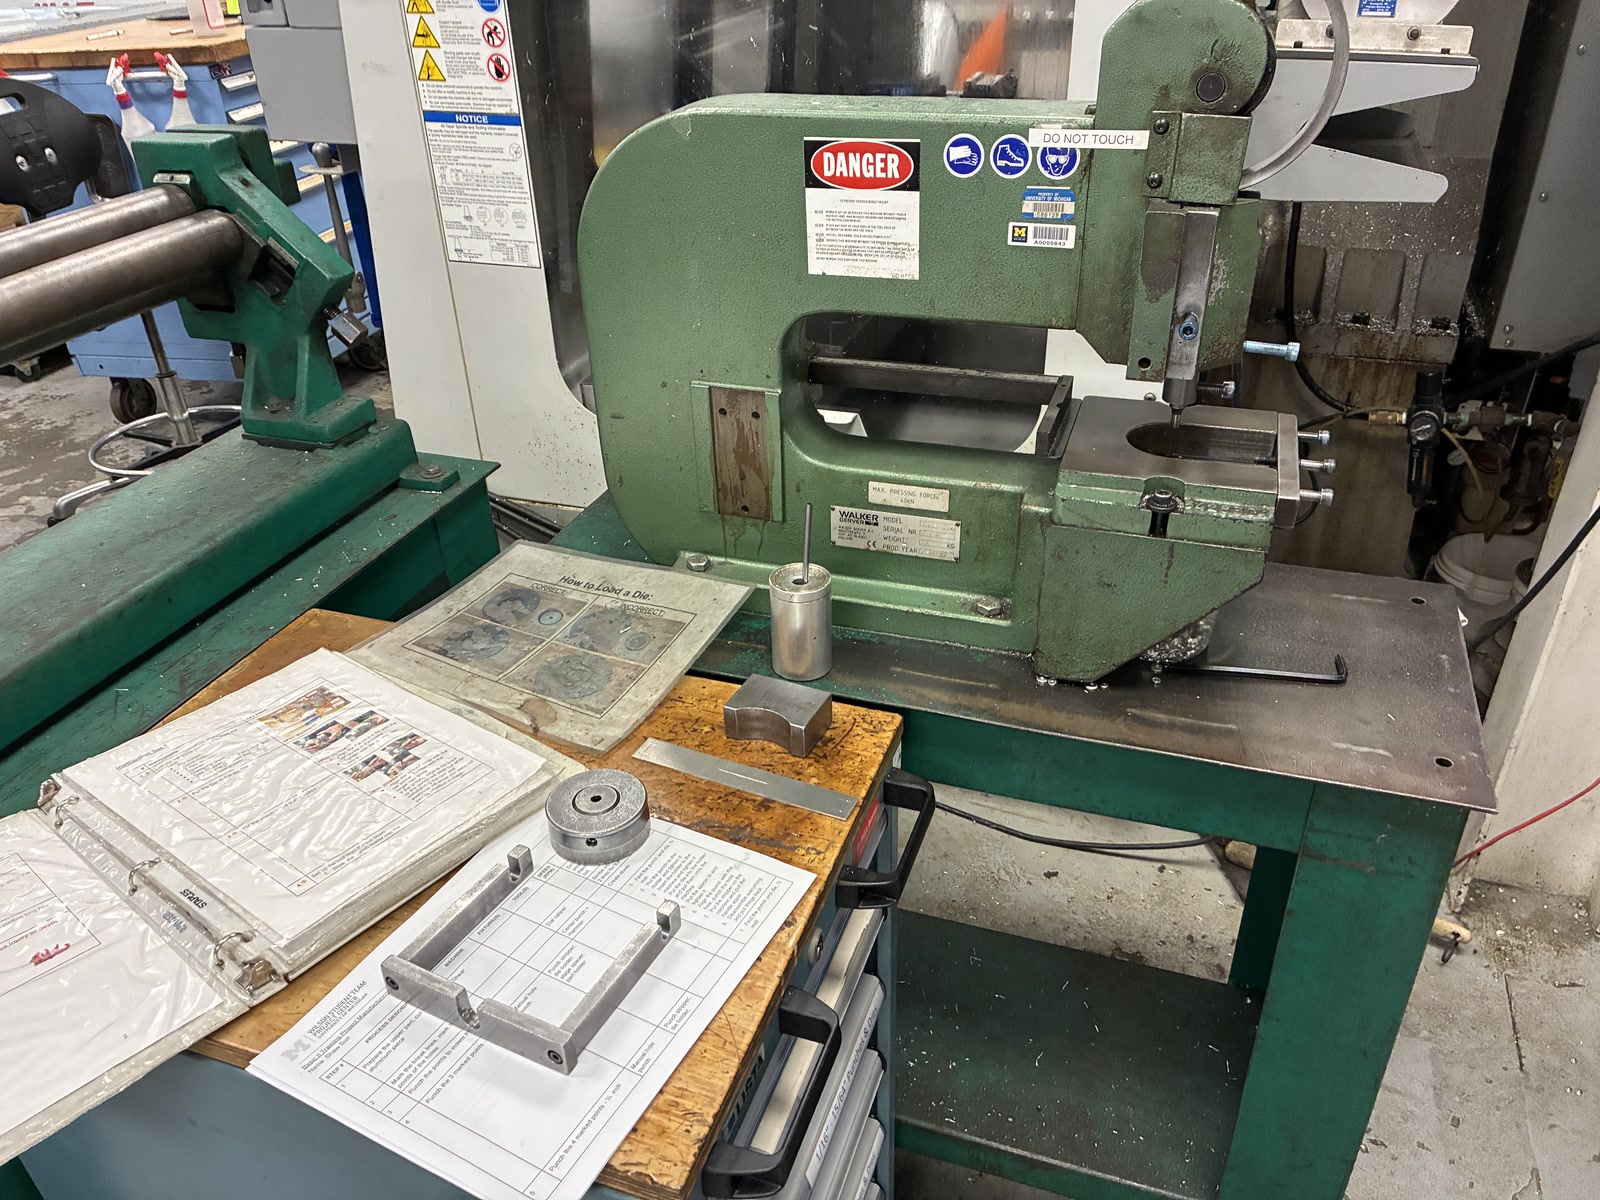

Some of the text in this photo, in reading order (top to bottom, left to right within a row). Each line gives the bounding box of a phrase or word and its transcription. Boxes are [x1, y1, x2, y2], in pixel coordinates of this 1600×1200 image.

[455, 114, 488, 124] NOTICE
[1043, 133, 1134, 145] DO NOT TOUCH
[823, 152, 900, 179] DANGER
[890, 488, 916, 497] PRESSING
[838, 510, 879, 521] WALKER
[883, 516, 902, 524] MODEL
[883, 525, 904, 534] SERIAL
[883, 535, 906, 544] WEIGHT
[901, 545, 918, 554] YEAR
[559, 575, 584, 586] How
[584, 581, 594, 590] to
[595, 584, 624, 596] Load
[631, 590, 654, 600] Die:
[646, 856, 659, 867] punch
[179, 888, 207, 908] STAPLES
[561, 920, 576, 933] Center
[573, 909, 588, 921] punch
[443, 948, 464, 966] MACHINE
[547, 944, 577, 973] Punch stripper,
[558, 952, 586, 979] stage spacer,
[559, 955, 575, 969] holder,
[564, 959, 588, 982] part holder
[525, 986, 537, 996] hole
[306, 980, 368, 1034] WILSON STUDENT TEAM
[312, 995, 359, 1036] PROJECT CENTER
[316, 1016, 342, 1038] UNIVERSITY
[346, 992, 368, 1011] MICHIGAN
[663, 996, 692, 1027] Punch stripper,
[675, 1007, 691, 1023] holder,
[363, 1020, 389, 1043] PROCESS
[390, 1036, 406, 1050] piece
[280, 1038, 311, 1062] M
[301, 1055, 319, 1070] Basic
[318, 1034, 342, 1054] Training
[338, 1019, 358, 1036] Project
[361, 1049, 384, 1069] Prepare
[388, 1028, 405, 1043] upper
[402, 1018, 416, 1030] part,
[389, 1071, 404, 1084] Mark
[410, 1049, 426, 1064] break
[423, 1037, 439, 1050] lines,
[436, 1026, 450, 1038] mark
[630, 1041, 655, 1069] Manual hole
[324, 1066, 341, 1080] STEP
[395, 1072, 413, 1088] points
[423, 1045, 439, 1060] holes
[406, 1076, 426, 1094] Punch
[430, 1054, 447, 1070] points
[449, 1035, 466, 1050] indent
[424, 1086, 444, 1104] Punch
[451, 1055, 472, 1075] marked
[468, 1042, 485, 1057] points
[637, 1057, 652, 1073] punch
[815, 1128, 829, 1162] 1/16"
[831, 1080, 847, 1119] 15/64"
[846, 1037, 865, 1082] Punches
[868, 1006, 879, 1028] Dies
[548, 1153, 567, 1172] Punch
[573, 1118, 594, 1140] marked
[589, 1103, 606, 1120] points
[610, 1082, 623, 1094] inch
